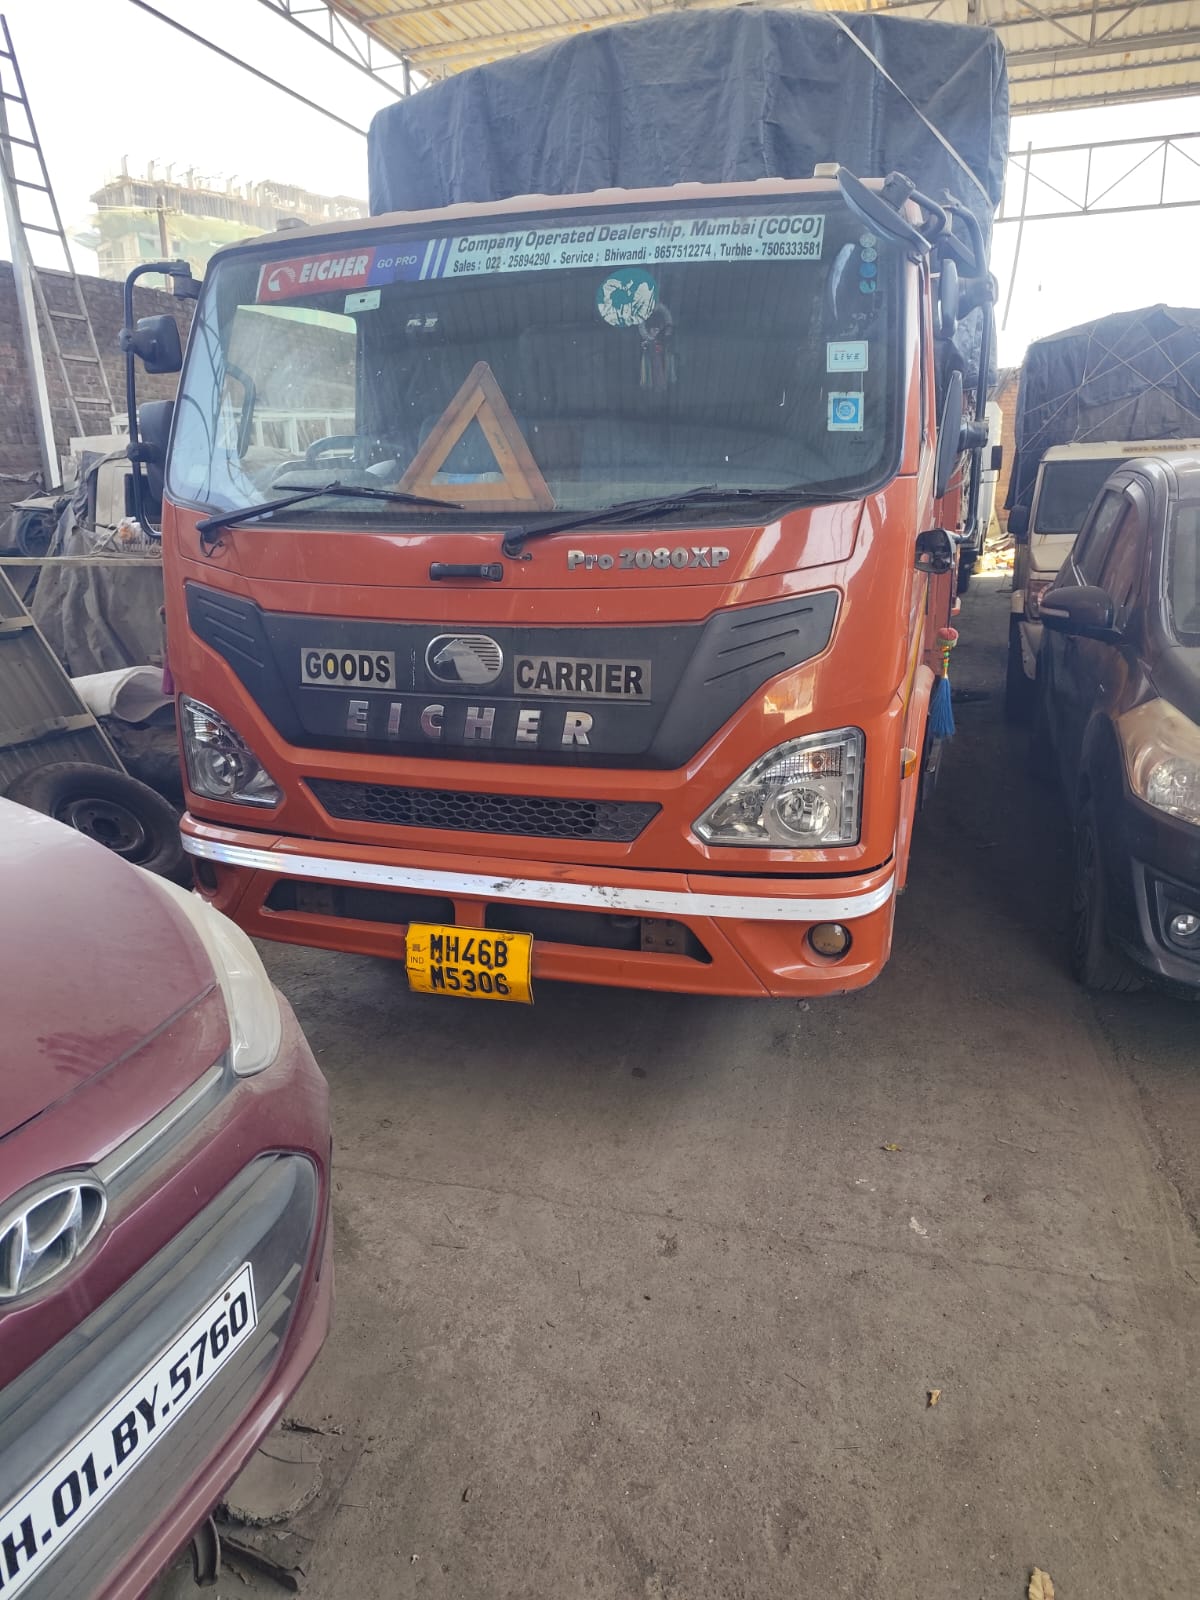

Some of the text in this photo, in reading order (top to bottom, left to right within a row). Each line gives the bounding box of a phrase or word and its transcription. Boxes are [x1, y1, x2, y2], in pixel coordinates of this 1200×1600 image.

[458, 233, 523, 254] Company
[525, 227, 597, 249] Operated
[690, 219, 757, 237] Mumbai
[604, 246, 647, 262] Bhiwandi
[720, 242, 753, 257] Turbhe
[761, 241, 821, 256] 7506333581
[298, 255, 417, 284] EICHER GO PRO
[567, 547, 730, 570] Pro 2080XP
[305, 652, 391, 683] GOODS
[517, 660, 643, 695] CARRIER
[346, 700, 594, 745] EICHER
[430, 933, 508, 968] MH46B
[430, 965, 510, 995] M5306
[0, 1291, 249, 1591] H.01.BY.5760
